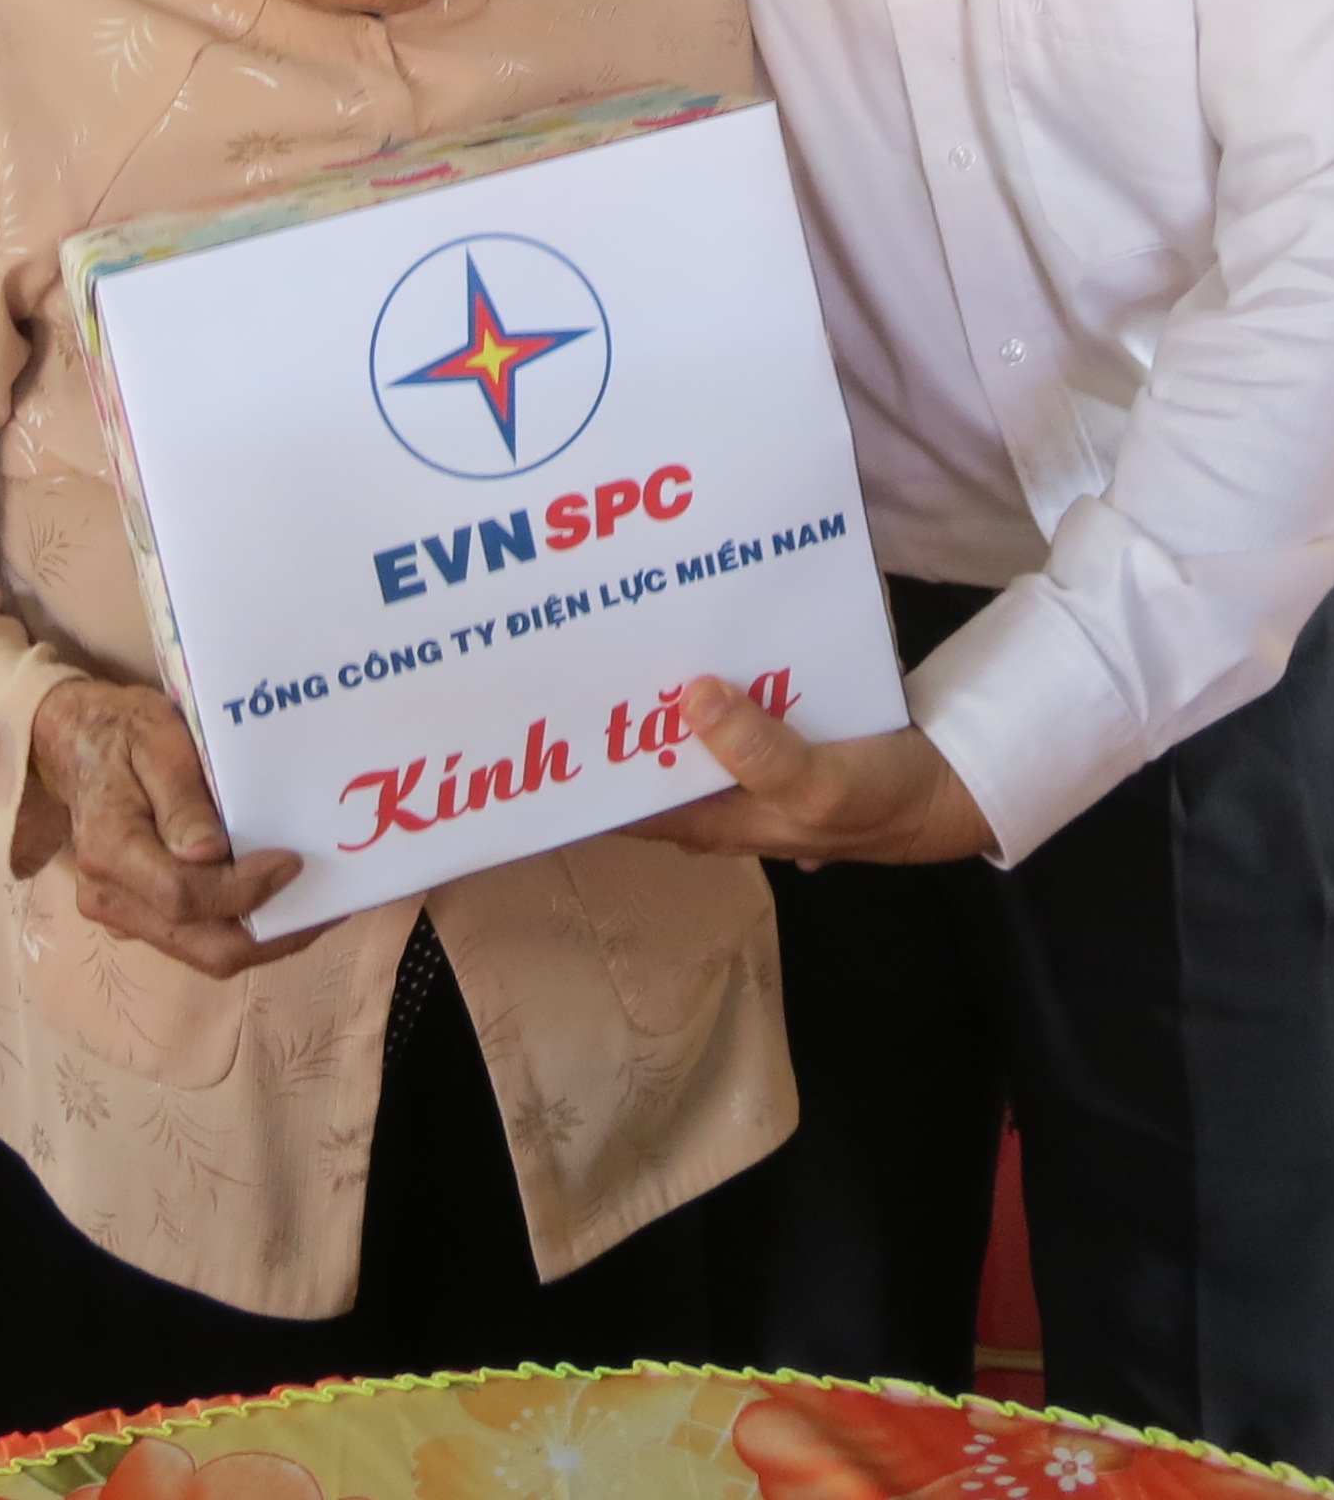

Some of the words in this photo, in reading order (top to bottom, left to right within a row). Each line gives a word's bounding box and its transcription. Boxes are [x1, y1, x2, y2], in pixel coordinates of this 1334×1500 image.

[222, 677, 330, 727] TỔNG
[337, 638, 444, 690] CÔNG
[450, 618, 497, 656] TY
[506, 589, 592, 638] ĐIỆN
[599, 567, 668, 609] LỰC
[676, 538, 764, 588] MIỀN
[772, 511, 848, 558] NAM
[336, 716, 583, 853] Kính
[603, 666, 803, 770] tặg
